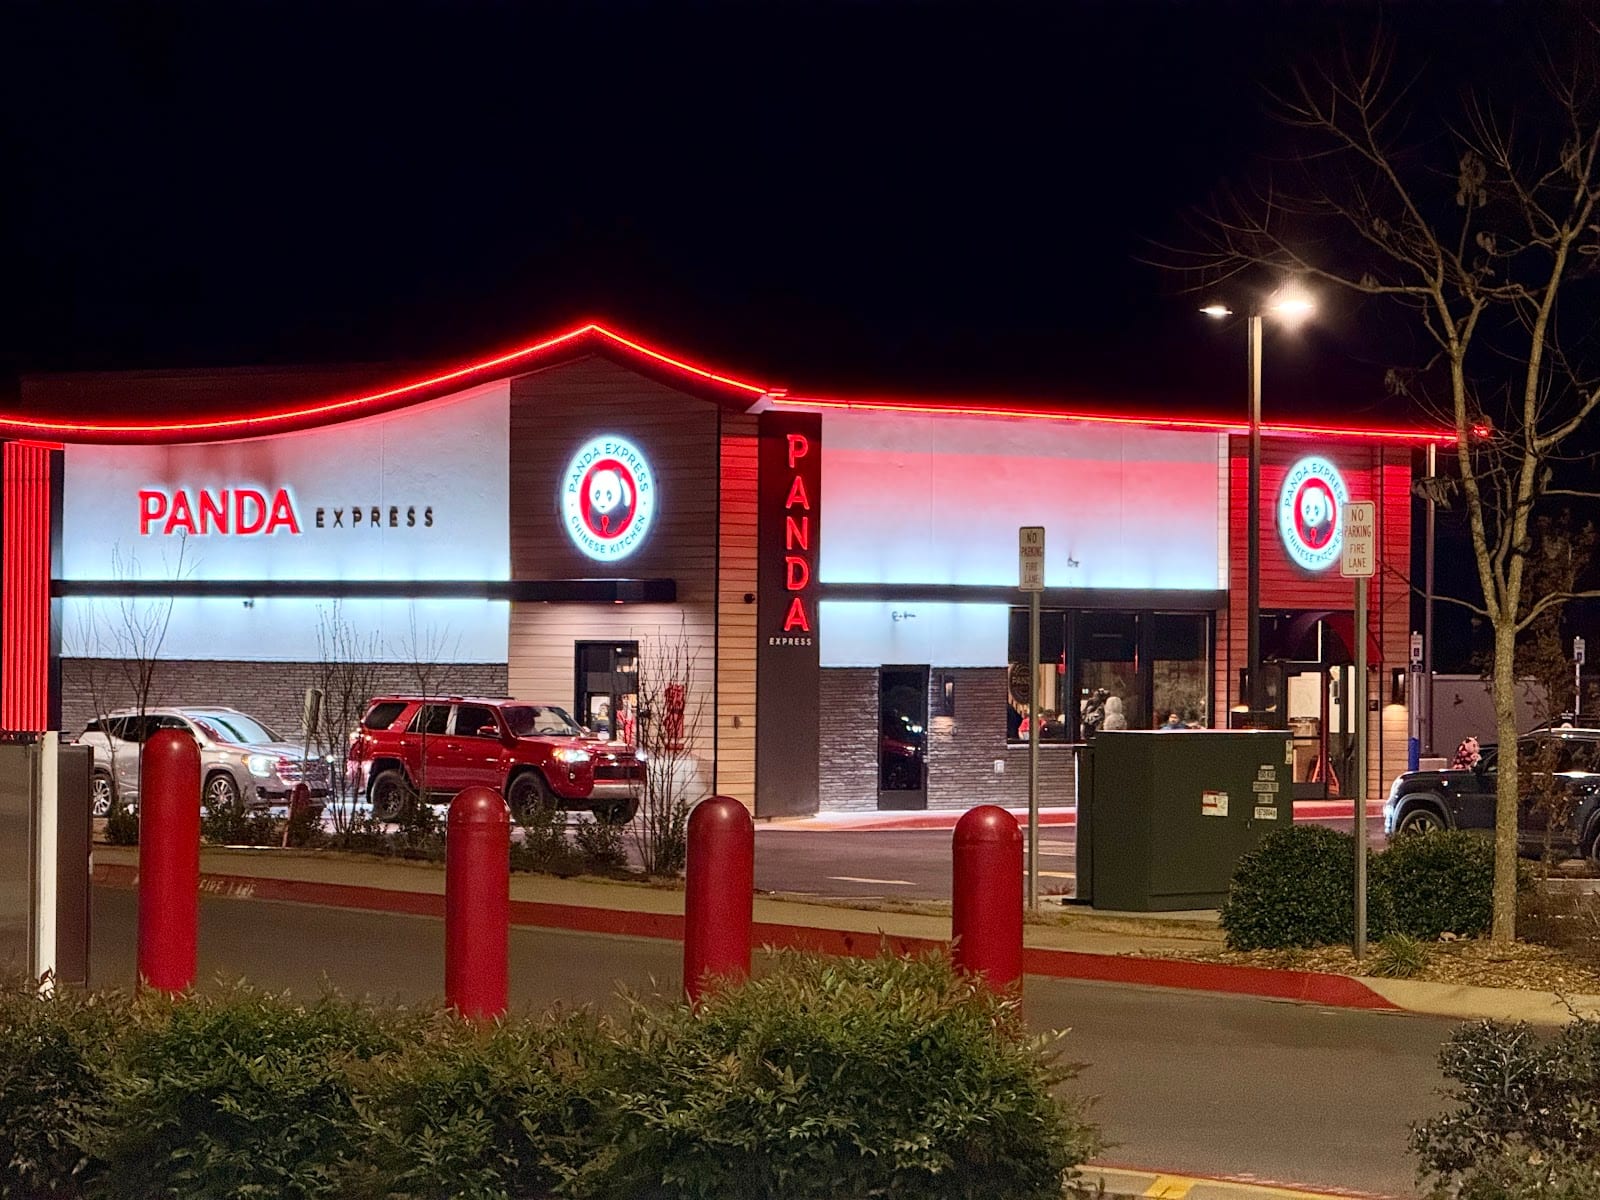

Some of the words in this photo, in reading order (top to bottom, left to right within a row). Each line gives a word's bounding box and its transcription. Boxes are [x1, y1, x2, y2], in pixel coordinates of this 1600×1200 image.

[569, 447, 601, 493] PANDA
[605, 443, 648, 492] EXPRESS
[1284, 466, 1310, 507] PANDA
[137, 487, 302, 535] PANDA
[315, 506, 434, 528] EXPRESS
[1351, 508, 1364, 522] NO
[571, 516, 606, 554] CHINESE
[610, 515, 646, 554] KITCHEN
[783, 433, 810, 632] PANDA
[1026, 532, 1038, 544] NO
[1344, 525, 1372, 539] PARKING
[1287, 527, 1313, 563] CHINESE
[1349, 543, 1366, 555] FIRE
[1348, 558, 1367, 569] LANE
[769, 637, 812, 646] EXPRESS
